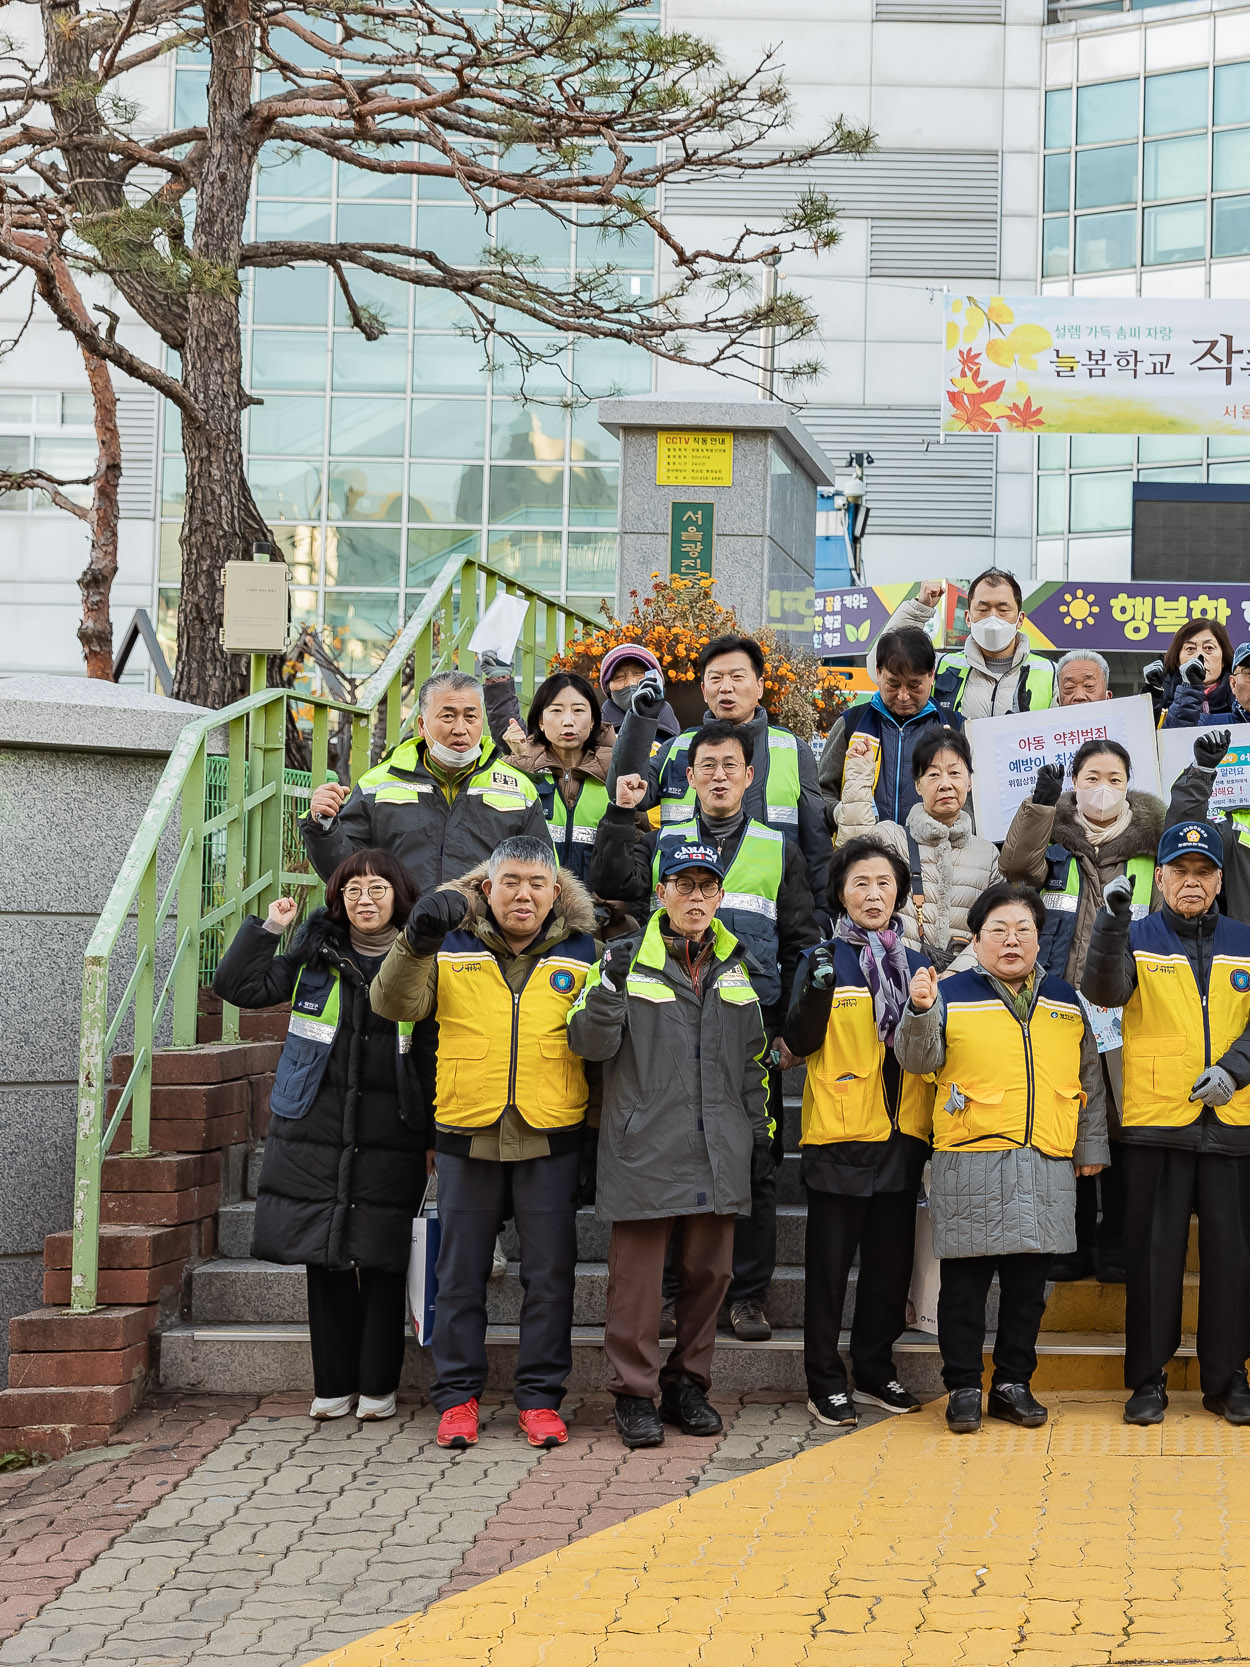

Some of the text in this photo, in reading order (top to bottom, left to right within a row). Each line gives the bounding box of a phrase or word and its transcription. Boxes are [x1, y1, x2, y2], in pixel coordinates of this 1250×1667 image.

[1054, 324, 1173, 341] 설렘 가득 솜씨 자랑
[1049, 348, 1175, 379] 늘봄학교
[665, 436, 690, 445] CCTV
[825, 595, 842, 612] 꿈을
[843, 594, 869, 610] 키우는
[824, 614, 842, 630] 학교
[823, 631, 841, 648] 학교
[1018, 726, 1108, 752] 아동 약취범죄
[1009, 755, 1046, 773] 예방이
[1220, 766, 1245, 777] 알려요
[674, 846, 717, 863] CANADA
